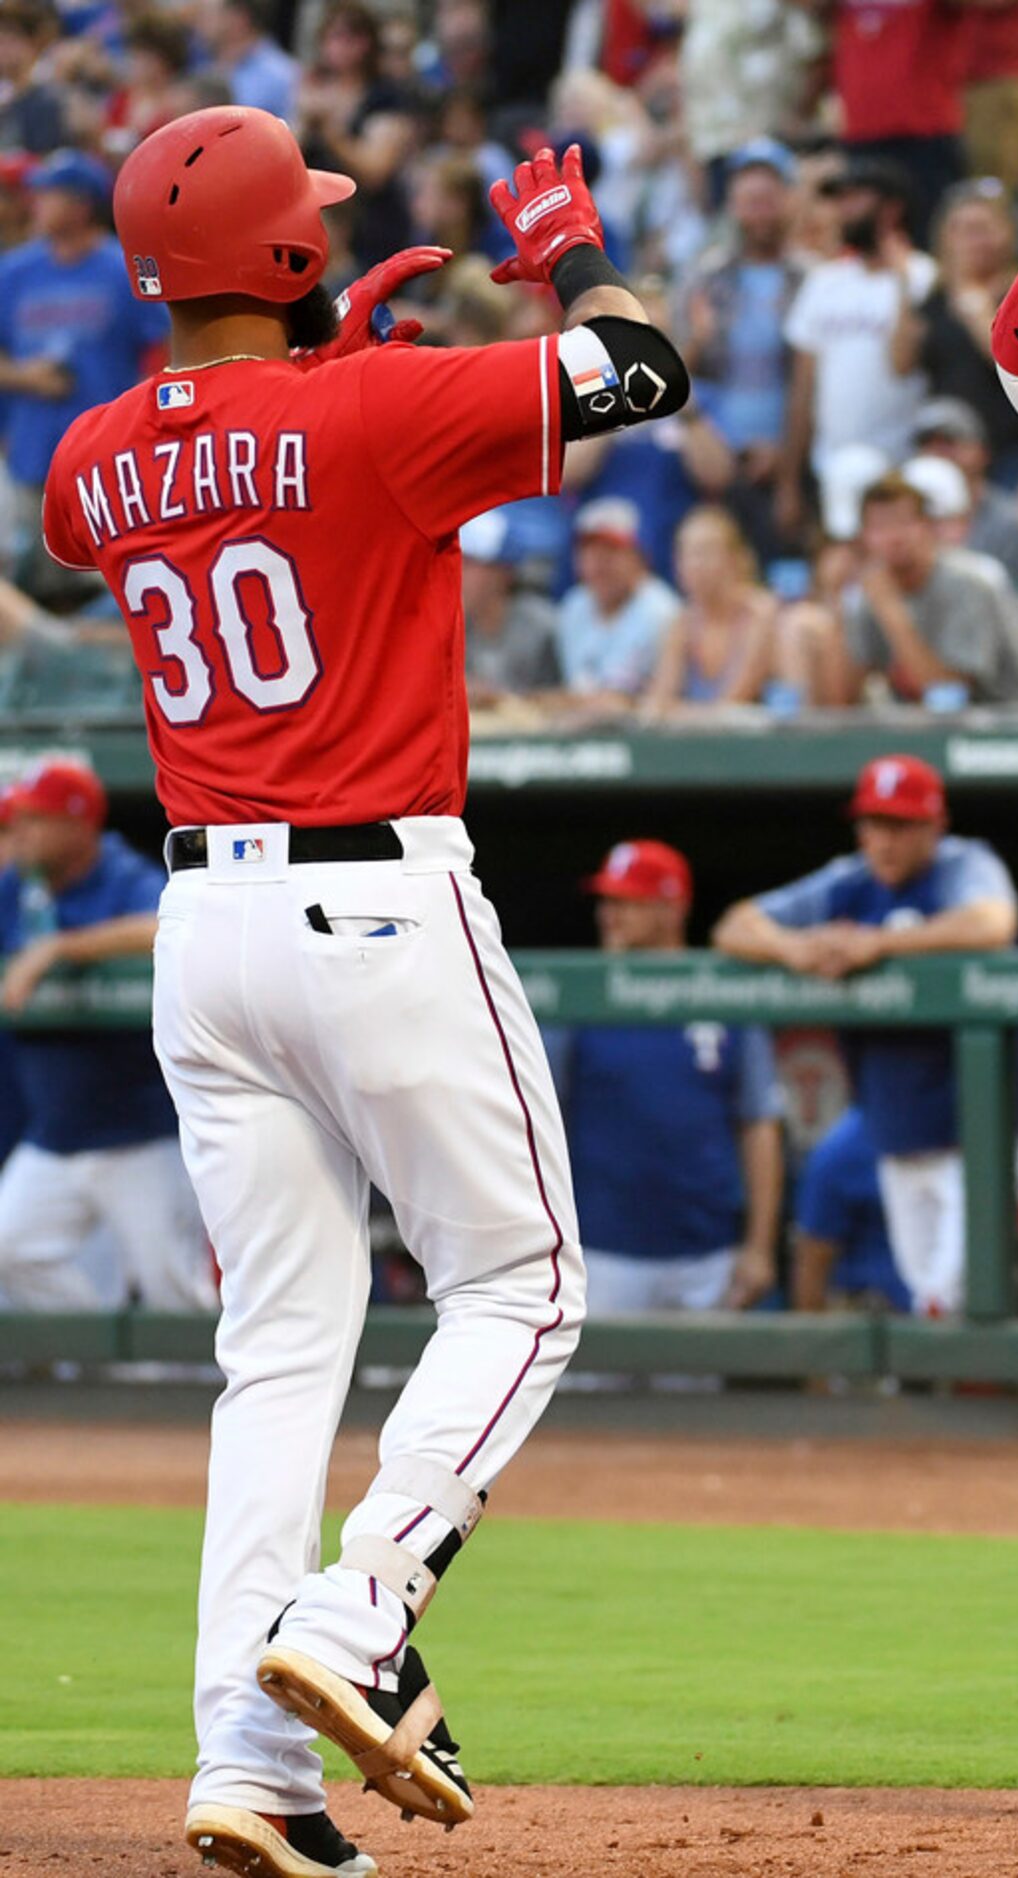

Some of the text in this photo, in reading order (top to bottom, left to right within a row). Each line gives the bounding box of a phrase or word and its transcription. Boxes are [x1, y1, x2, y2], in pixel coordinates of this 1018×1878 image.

[133, 255, 159, 278] 30
[76, 428, 312, 547] MAZARA
[121, 534, 324, 729] 30
